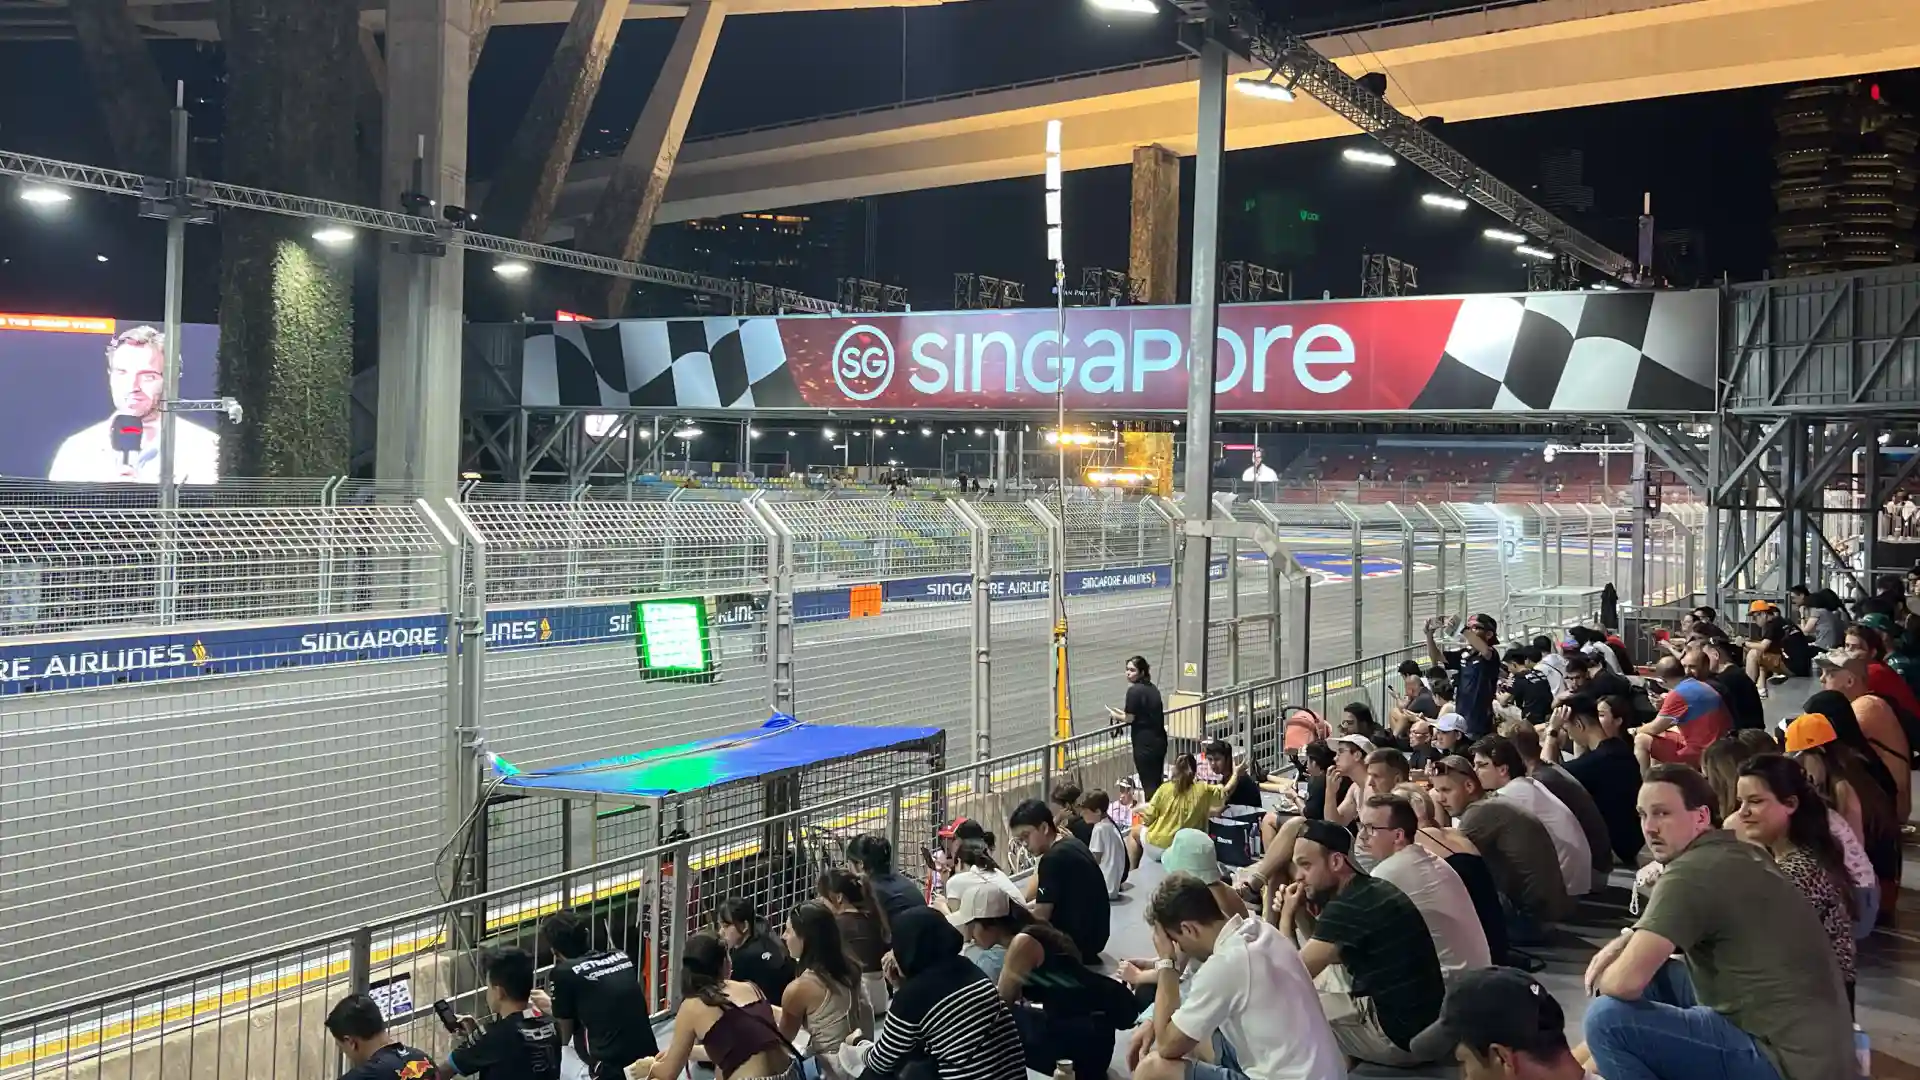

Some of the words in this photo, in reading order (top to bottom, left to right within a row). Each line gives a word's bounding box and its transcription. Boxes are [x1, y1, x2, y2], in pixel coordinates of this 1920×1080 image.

[840, 346, 887, 379] SG
[1007, 579, 1050, 594] AIRLINE
[1081, 577, 1122, 589] SINGAPORE
[1122, 573, 1152, 585] AIRLINES
[300, 626, 438, 652] SINGAPORE
[44, 644, 187, 678] AIRLINES
